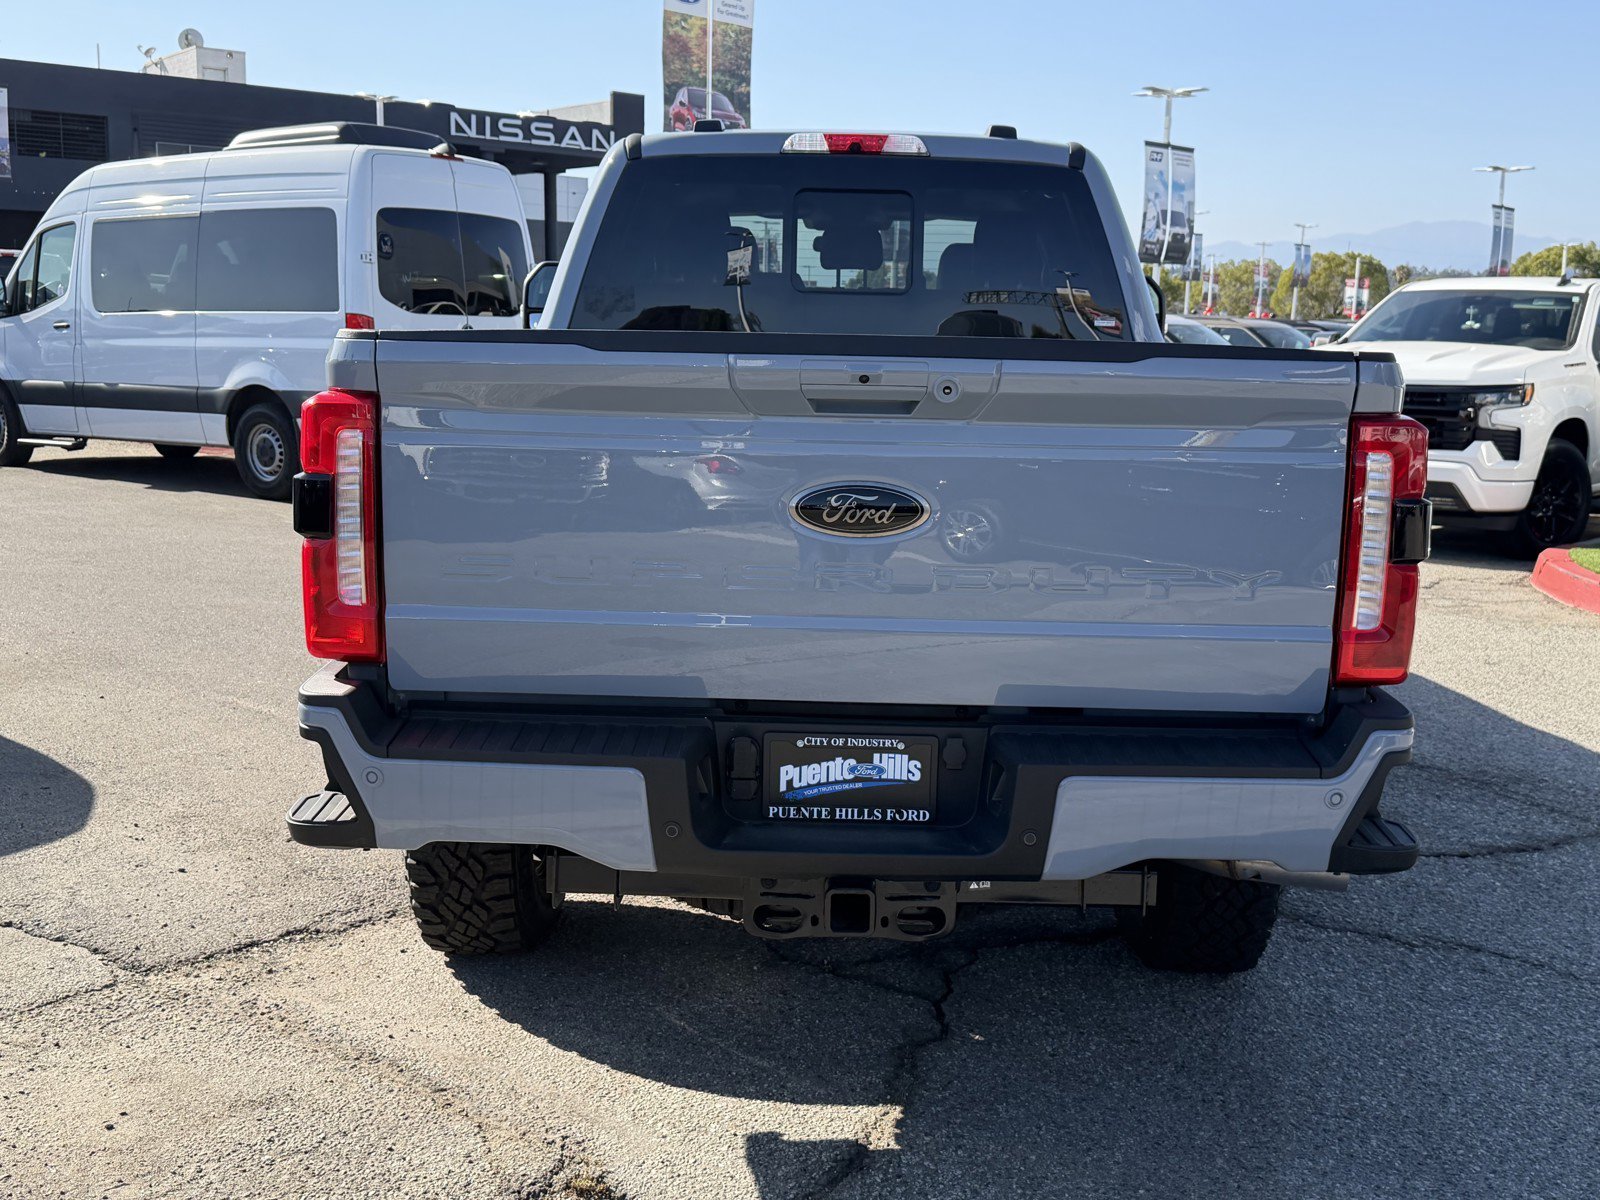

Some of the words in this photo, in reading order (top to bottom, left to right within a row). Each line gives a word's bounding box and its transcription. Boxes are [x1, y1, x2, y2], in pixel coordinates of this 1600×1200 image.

[450, 111, 615, 152] NISSAN
[822, 493, 897, 524] Ford
[930, 562, 1283, 600] DUTY
[804, 736, 829, 746] CITY
[831, 738, 844, 746] OF
[848, 738, 899, 747] INDUSTRY
[779, 756, 857, 792] Puente
[873, 753, 921, 781] Hills
[854, 765, 879, 775] Ford
[804, 787, 819, 796] YOUR
[818, 784, 842, 793] TRUSTED
[842, 782, 863, 790] DEALER
[768, 806, 831, 819] PUENTE
[835, 807, 882, 820] HILLS
[886, 808, 930, 822] FORD
